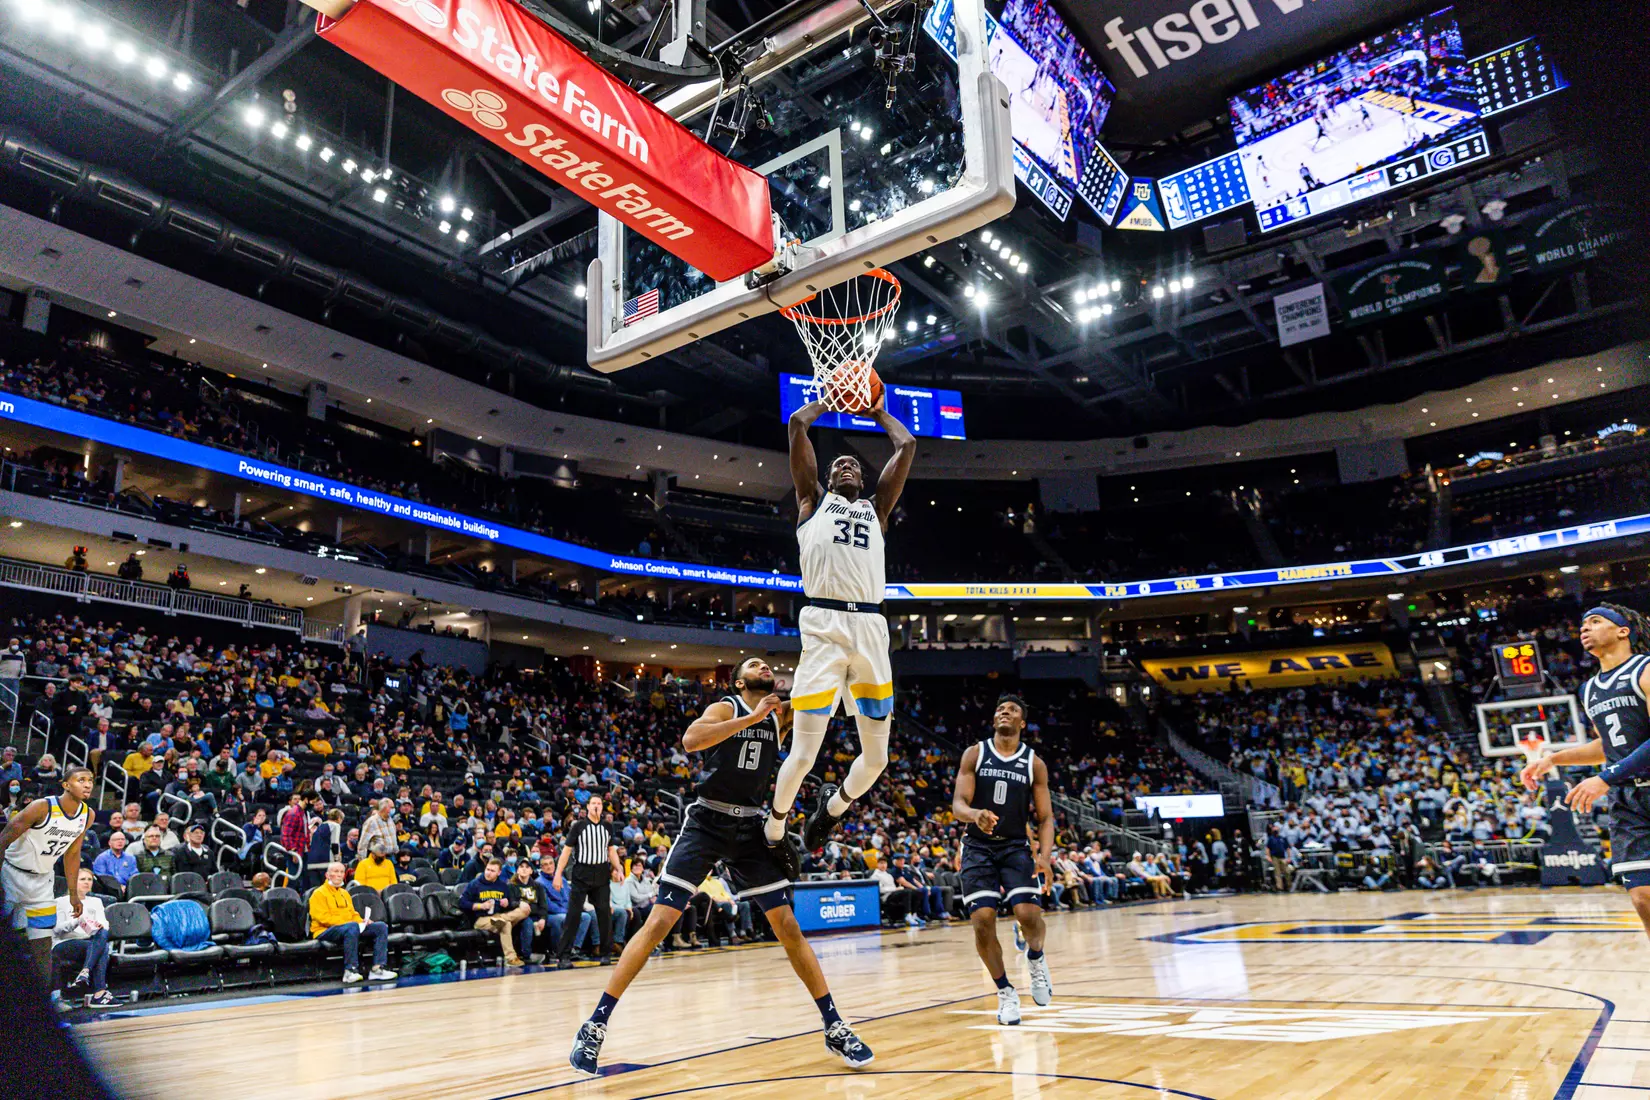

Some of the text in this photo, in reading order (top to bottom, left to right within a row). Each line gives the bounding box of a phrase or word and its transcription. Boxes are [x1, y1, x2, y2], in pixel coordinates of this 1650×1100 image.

[1394, 163, 1418, 182] 31
[1536, 245, 1576, 264] WORLD
[239, 461, 499, 539] Powering smart, safe, healthy and sustainable buildings
[833, 518, 870, 550] 35
[1577, 522, 1617, 541] 2nd
[610, 559, 643, 572] Johnson
[645, 563, 681, 577] Controls,
[682, 568, 706, 579] smart
[707, 570, 736, 584] building
[738, 575, 765, 584] partner
[766, 577, 775, 586] of
[775, 577, 797, 588] Fiserv
[1277, 564, 1353, 581] MARQUETTE
[1138, 582, 1151, 595] 0
[1160, 651, 1384, 682] WE ARE
[1511, 656, 1535, 676] 16
[733, 728, 775, 742] EORETOWN
[1605, 713, 1627, 747] 2
[737, 740, 763, 771] 13
[979, 768, 1027, 784] GEORGETOWN
[993, 780, 1008, 805] 0
[40, 840, 70, 857] 32
[1543, 850, 1597, 870] meijer
[820, 903, 856, 919] GRUBER
